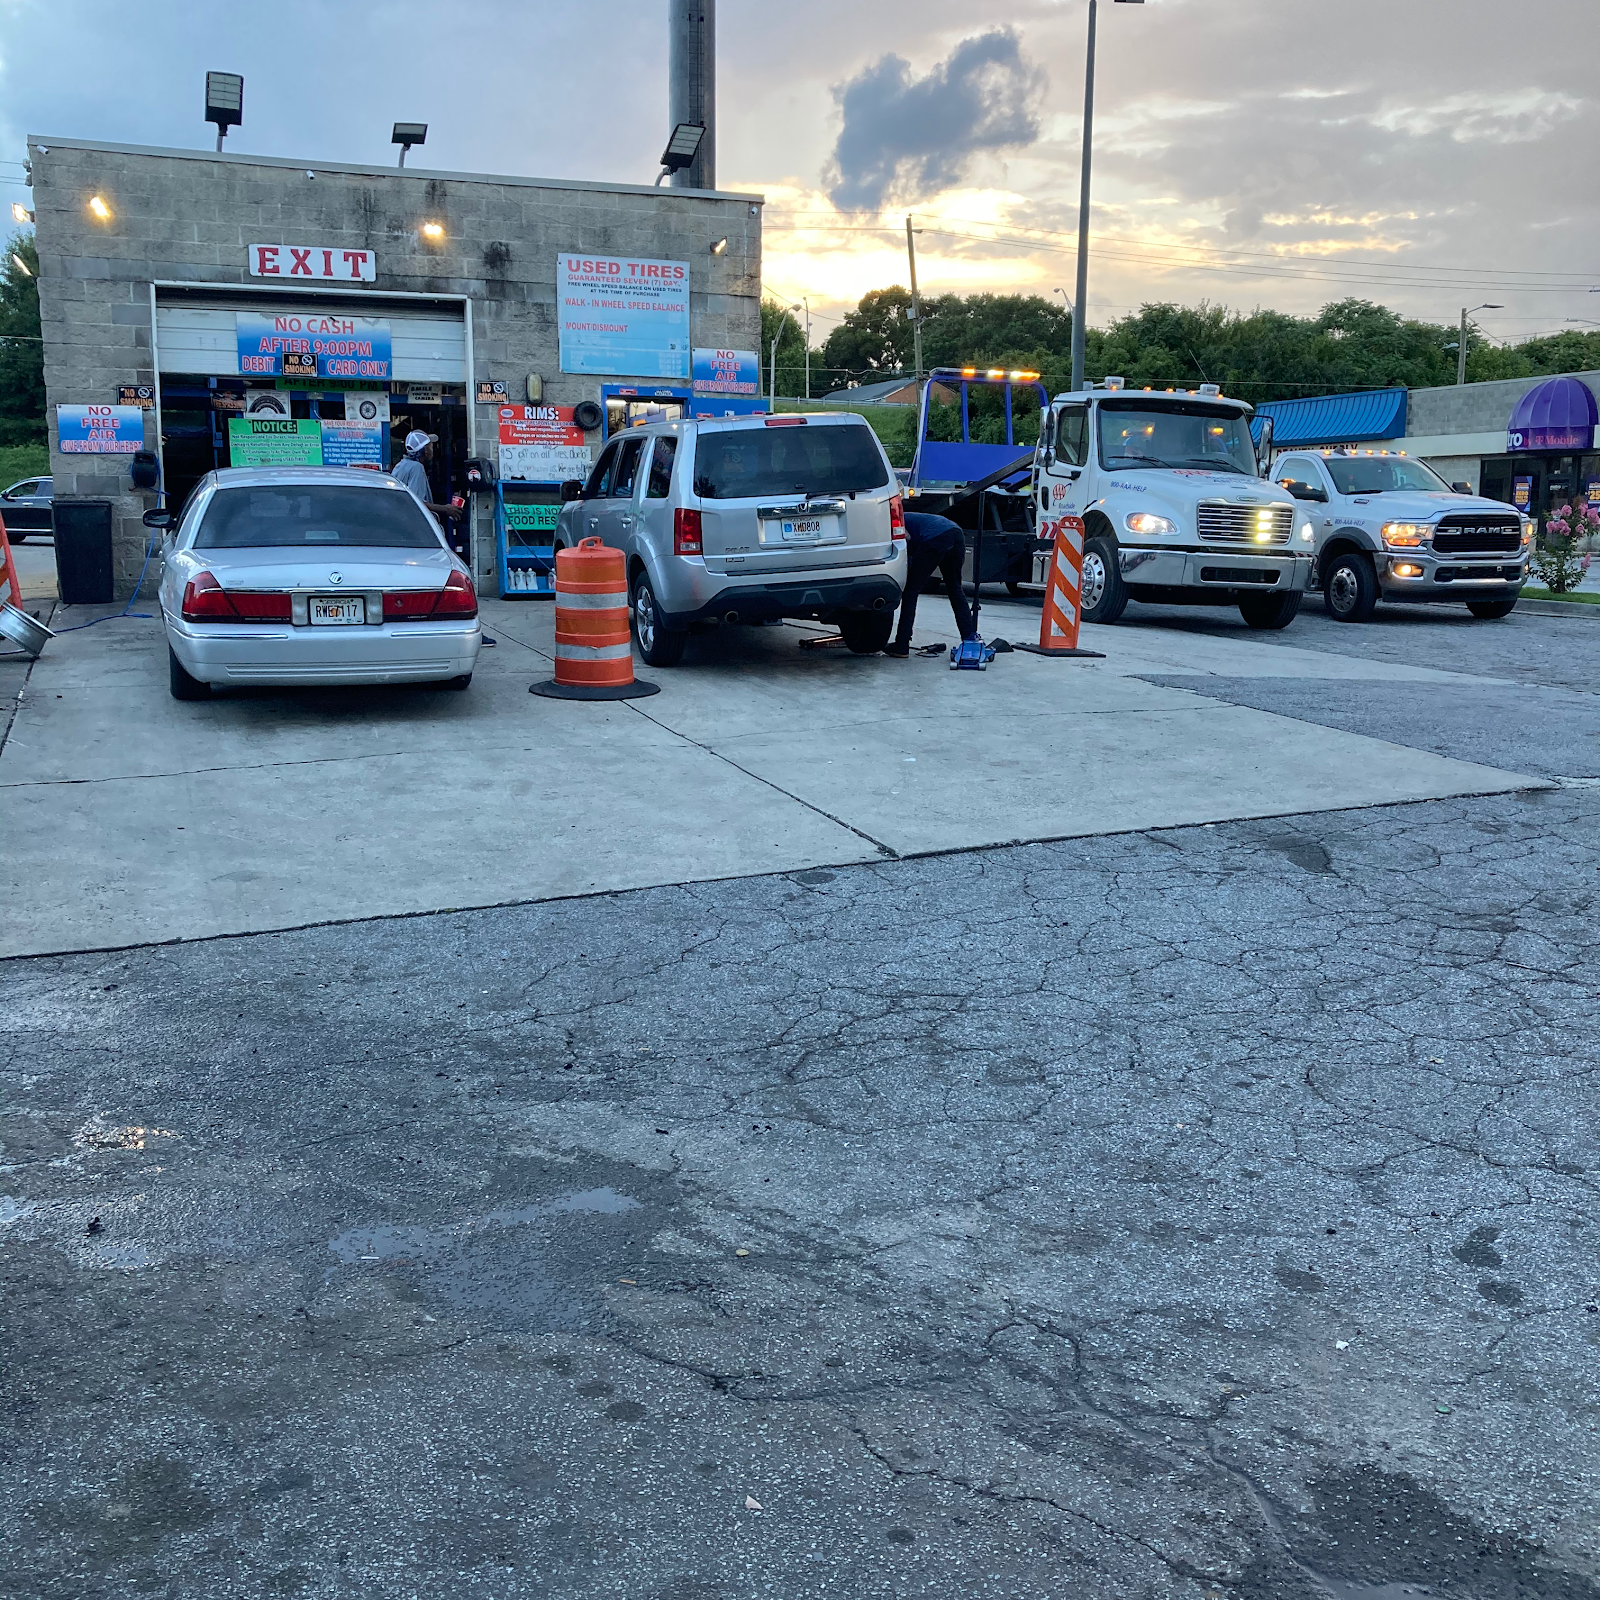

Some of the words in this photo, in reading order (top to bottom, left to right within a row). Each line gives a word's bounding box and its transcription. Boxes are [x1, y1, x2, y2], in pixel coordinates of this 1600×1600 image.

[257, 247, 367, 278] EXIT
[567, 259, 621, 275] USED
[627, 263, 684, 279] TIRES
[568, 274, 621, 283] GUARANTEED
[623, 277, 649, 285] SEVEN
[651, 279, 661, 287] (7)
[565, 297, 586, 307] WALK
[592, 299, 599, 308] IN
[601, 300, 626, 309] WHEEL
[628, 301, 651, 310] SPEED
[652, 303, 685, 312] BALANCE
[275, 317, 302, 333] NO
[307, 318, 354, 335] CASH
[258, 337, 310, 354] AFTER
[313, 340, 372, 357] 9:00PM
[289, 356, 299, 365] NO
[716, 350, 735, 360] NO
[242, 356, 275, 373] DEBIT
[327, 359, 359, 375] CARD
[360, 361, 388, 377] ONLY
[284, 364, 316, 374] SMOKING
[710, 360, 741, 371] FREE
[715, 371, 736, 381] AIR
[284, 377, 325, 389] AFTER
[329, 379, 354, 390] 9:00
[360, 380, 378, 391] PM
[481, 384, 492, 393] NO
[693, 380, 707, 391] GIVE
[708, 381, 724, 392] FROM
[724, 381, 739, 392] YOUR
[739, 382, 757, 393] HEART
[124, 388, 135, 398] NO
[478, 392, 507, 402] SMOKING
[120, 398, 153, 407] SMOKING
[88, 406, 112, 416] NO
[524, 406, 559, 421] RIMS:
[81, 418, 120, 428] FREE
[253, 421, 297, 433] NOTICE:
[88, 429, 116, 440] AIR
[351, 431, 365, 439] TIRES
[1507, 431, 1523, 447] tro
[1523, 436, 1533, 447] by
[1545, 434, 1579, 445] Mobile
[61, 440, 79, 453] GIVE
[80, 440, 99, 453] FROM
[100, 440, 120, 453] YOUR
[120, 440, 143, 453] HEART
[517, 447, 529, 459] off
[530, 451, 540, 459] on
[541, 450, 550, 459] all
[1110, 480, 1147, 492] 800-AAA-HELP
[508, 507, 531, 515] THIS
[532, 507, 542, 515] IS
[544, 507, 562, 516] NOT
[508, 516, 535, 526] FOOD
[537, 515, 556, 526] RES
[1334, 518, 1365, 526] 800-AAA-HELP
[1463, 526, 1500, 534] RAM
[315, 604, 357, 618] RWE7117
